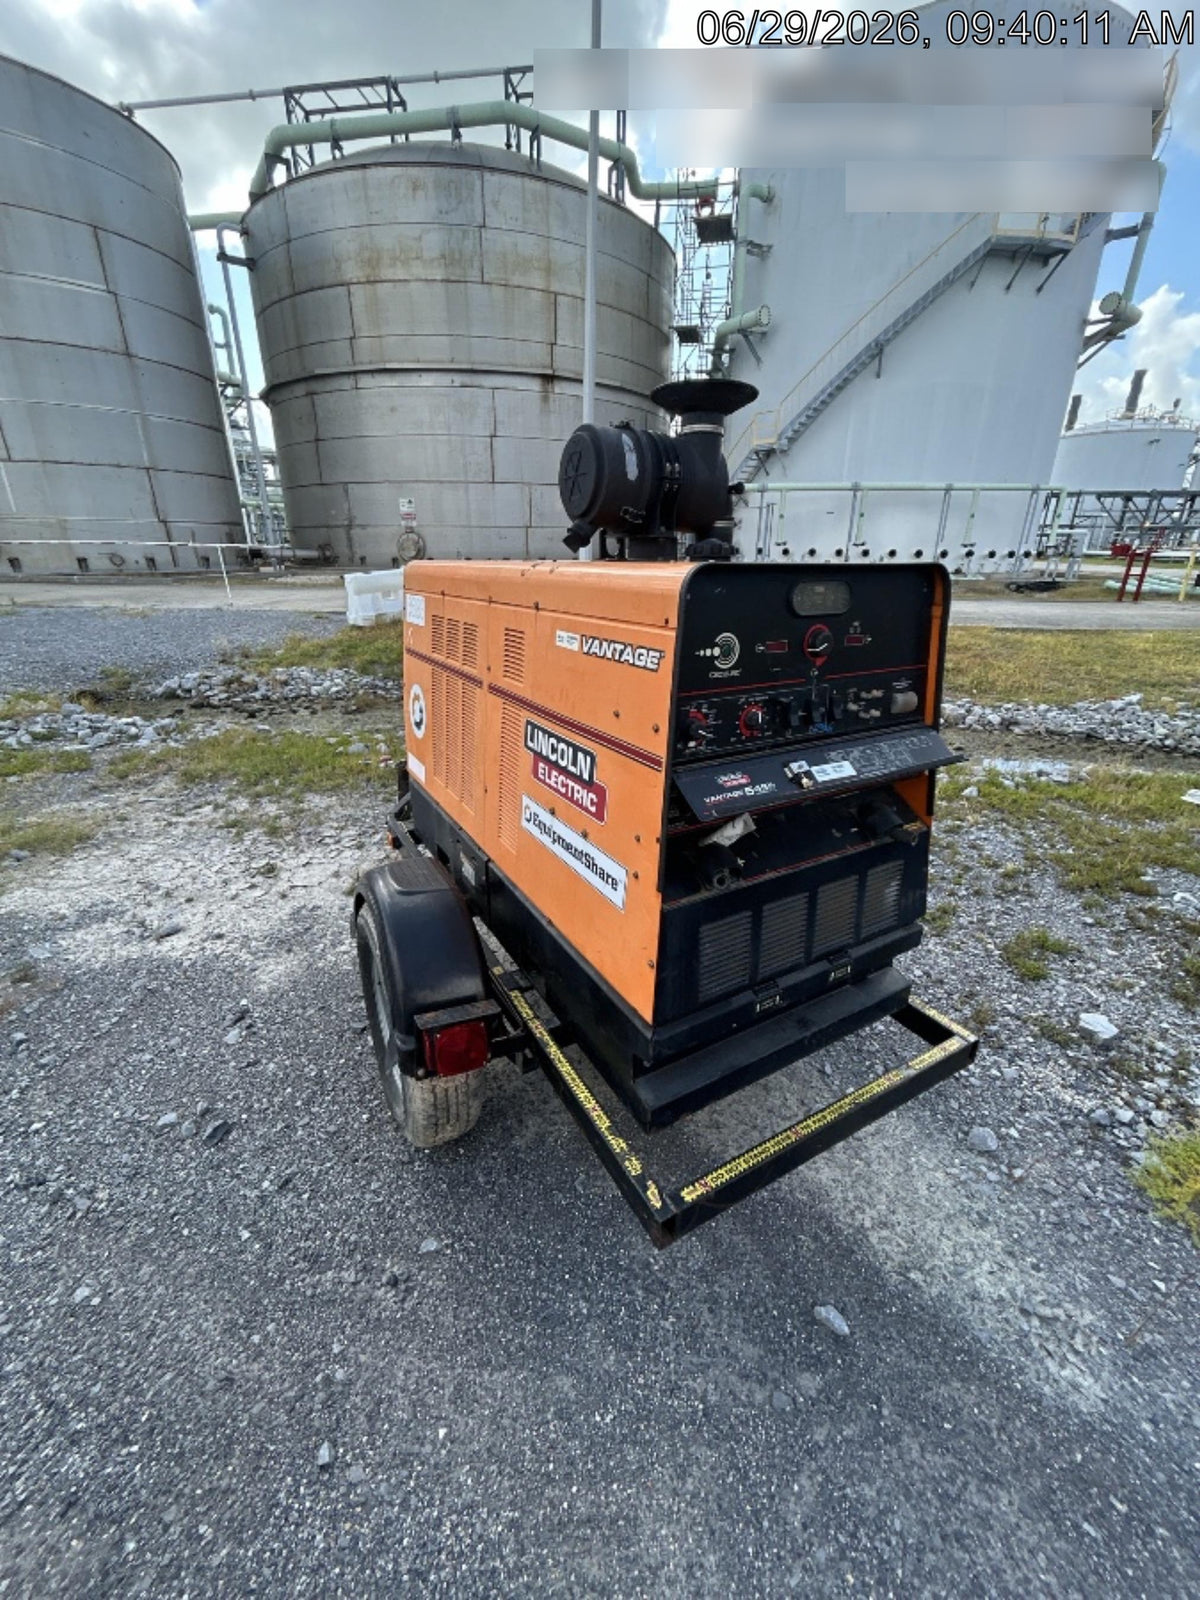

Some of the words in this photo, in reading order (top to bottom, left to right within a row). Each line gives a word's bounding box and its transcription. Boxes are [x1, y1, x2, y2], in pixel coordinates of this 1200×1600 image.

[581, 635, 661, 671] VANTAGE
[527, 724, 591, 782] LINCOLN
[538, 762, 598, 814] ELECTRIC
[532, 810, 619, 892] EquipmentShare
